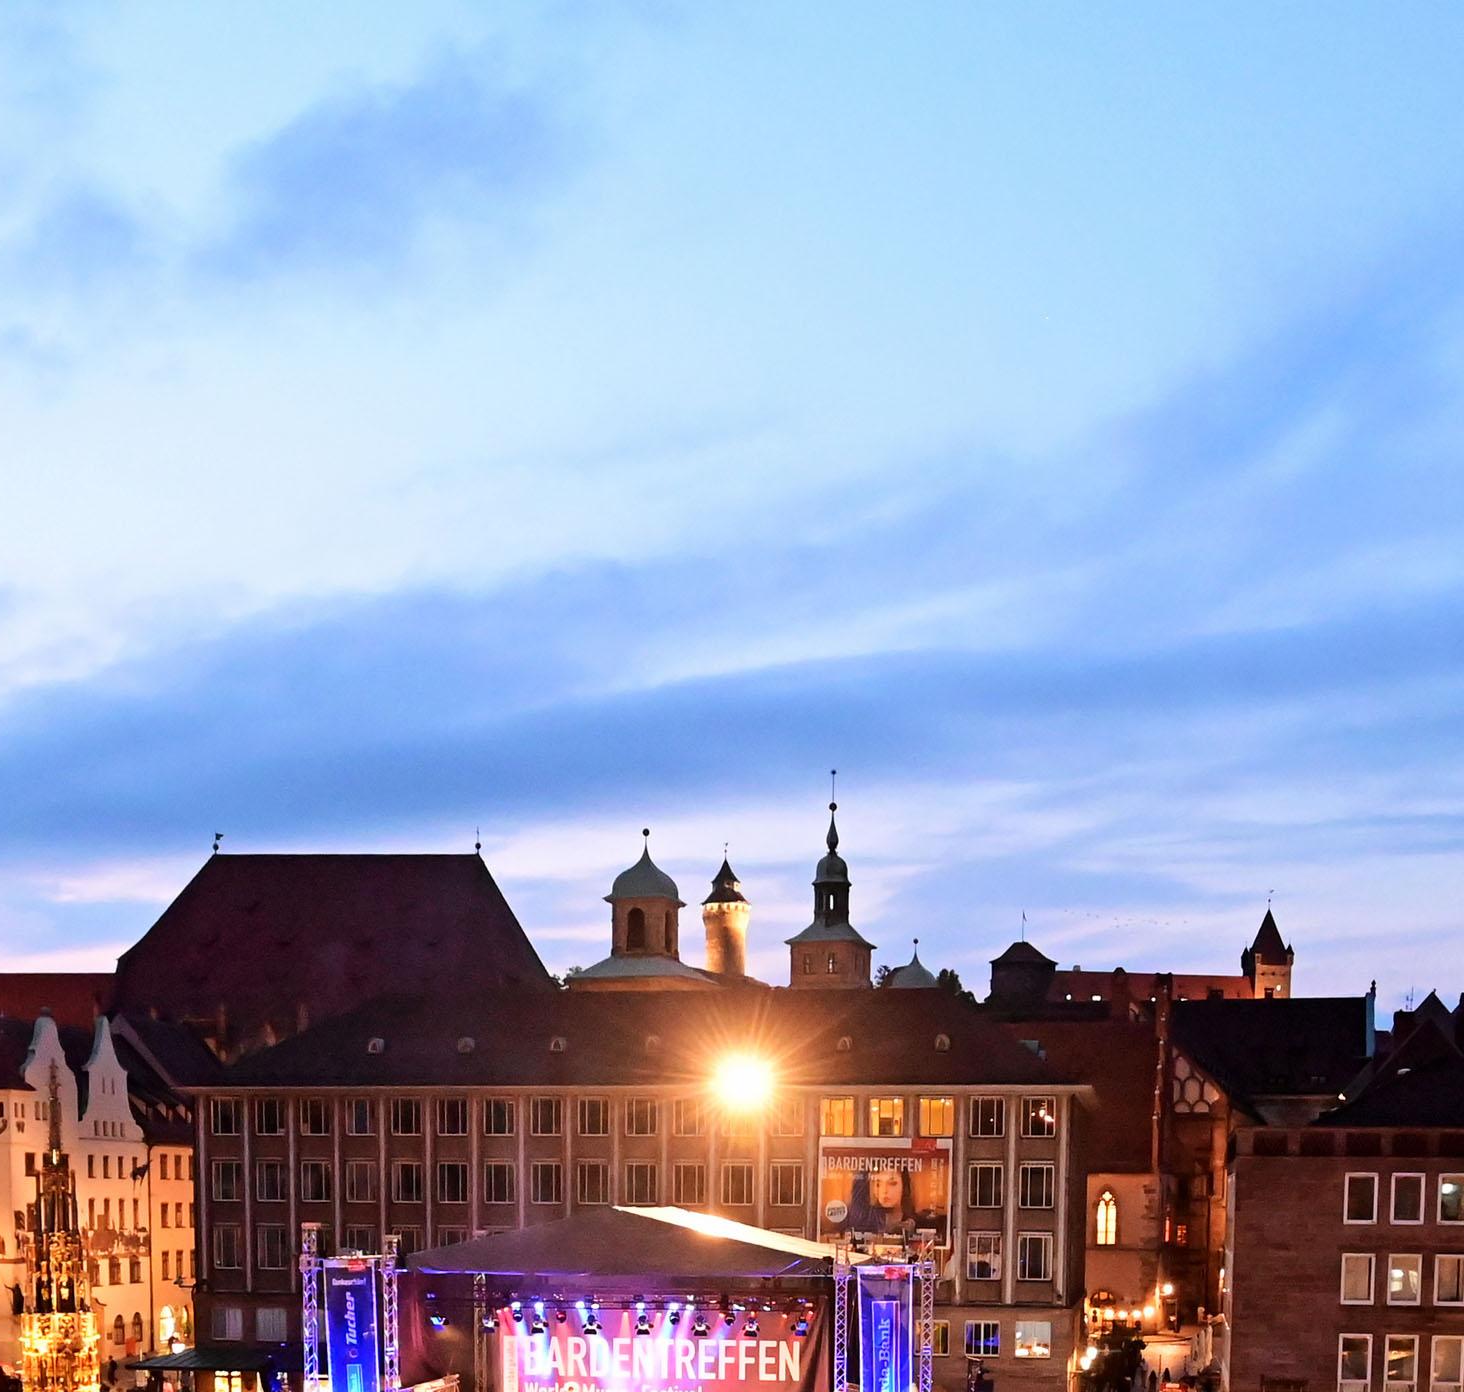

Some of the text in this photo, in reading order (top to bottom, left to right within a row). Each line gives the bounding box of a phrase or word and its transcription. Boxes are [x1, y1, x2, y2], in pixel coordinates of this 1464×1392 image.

[828, 1156, 923, 1173] BARDENTREFFEN
[345, 1291, 358, 1346] Tucher
[524, 1335, 801, 1382] BARDENTREFFEN
